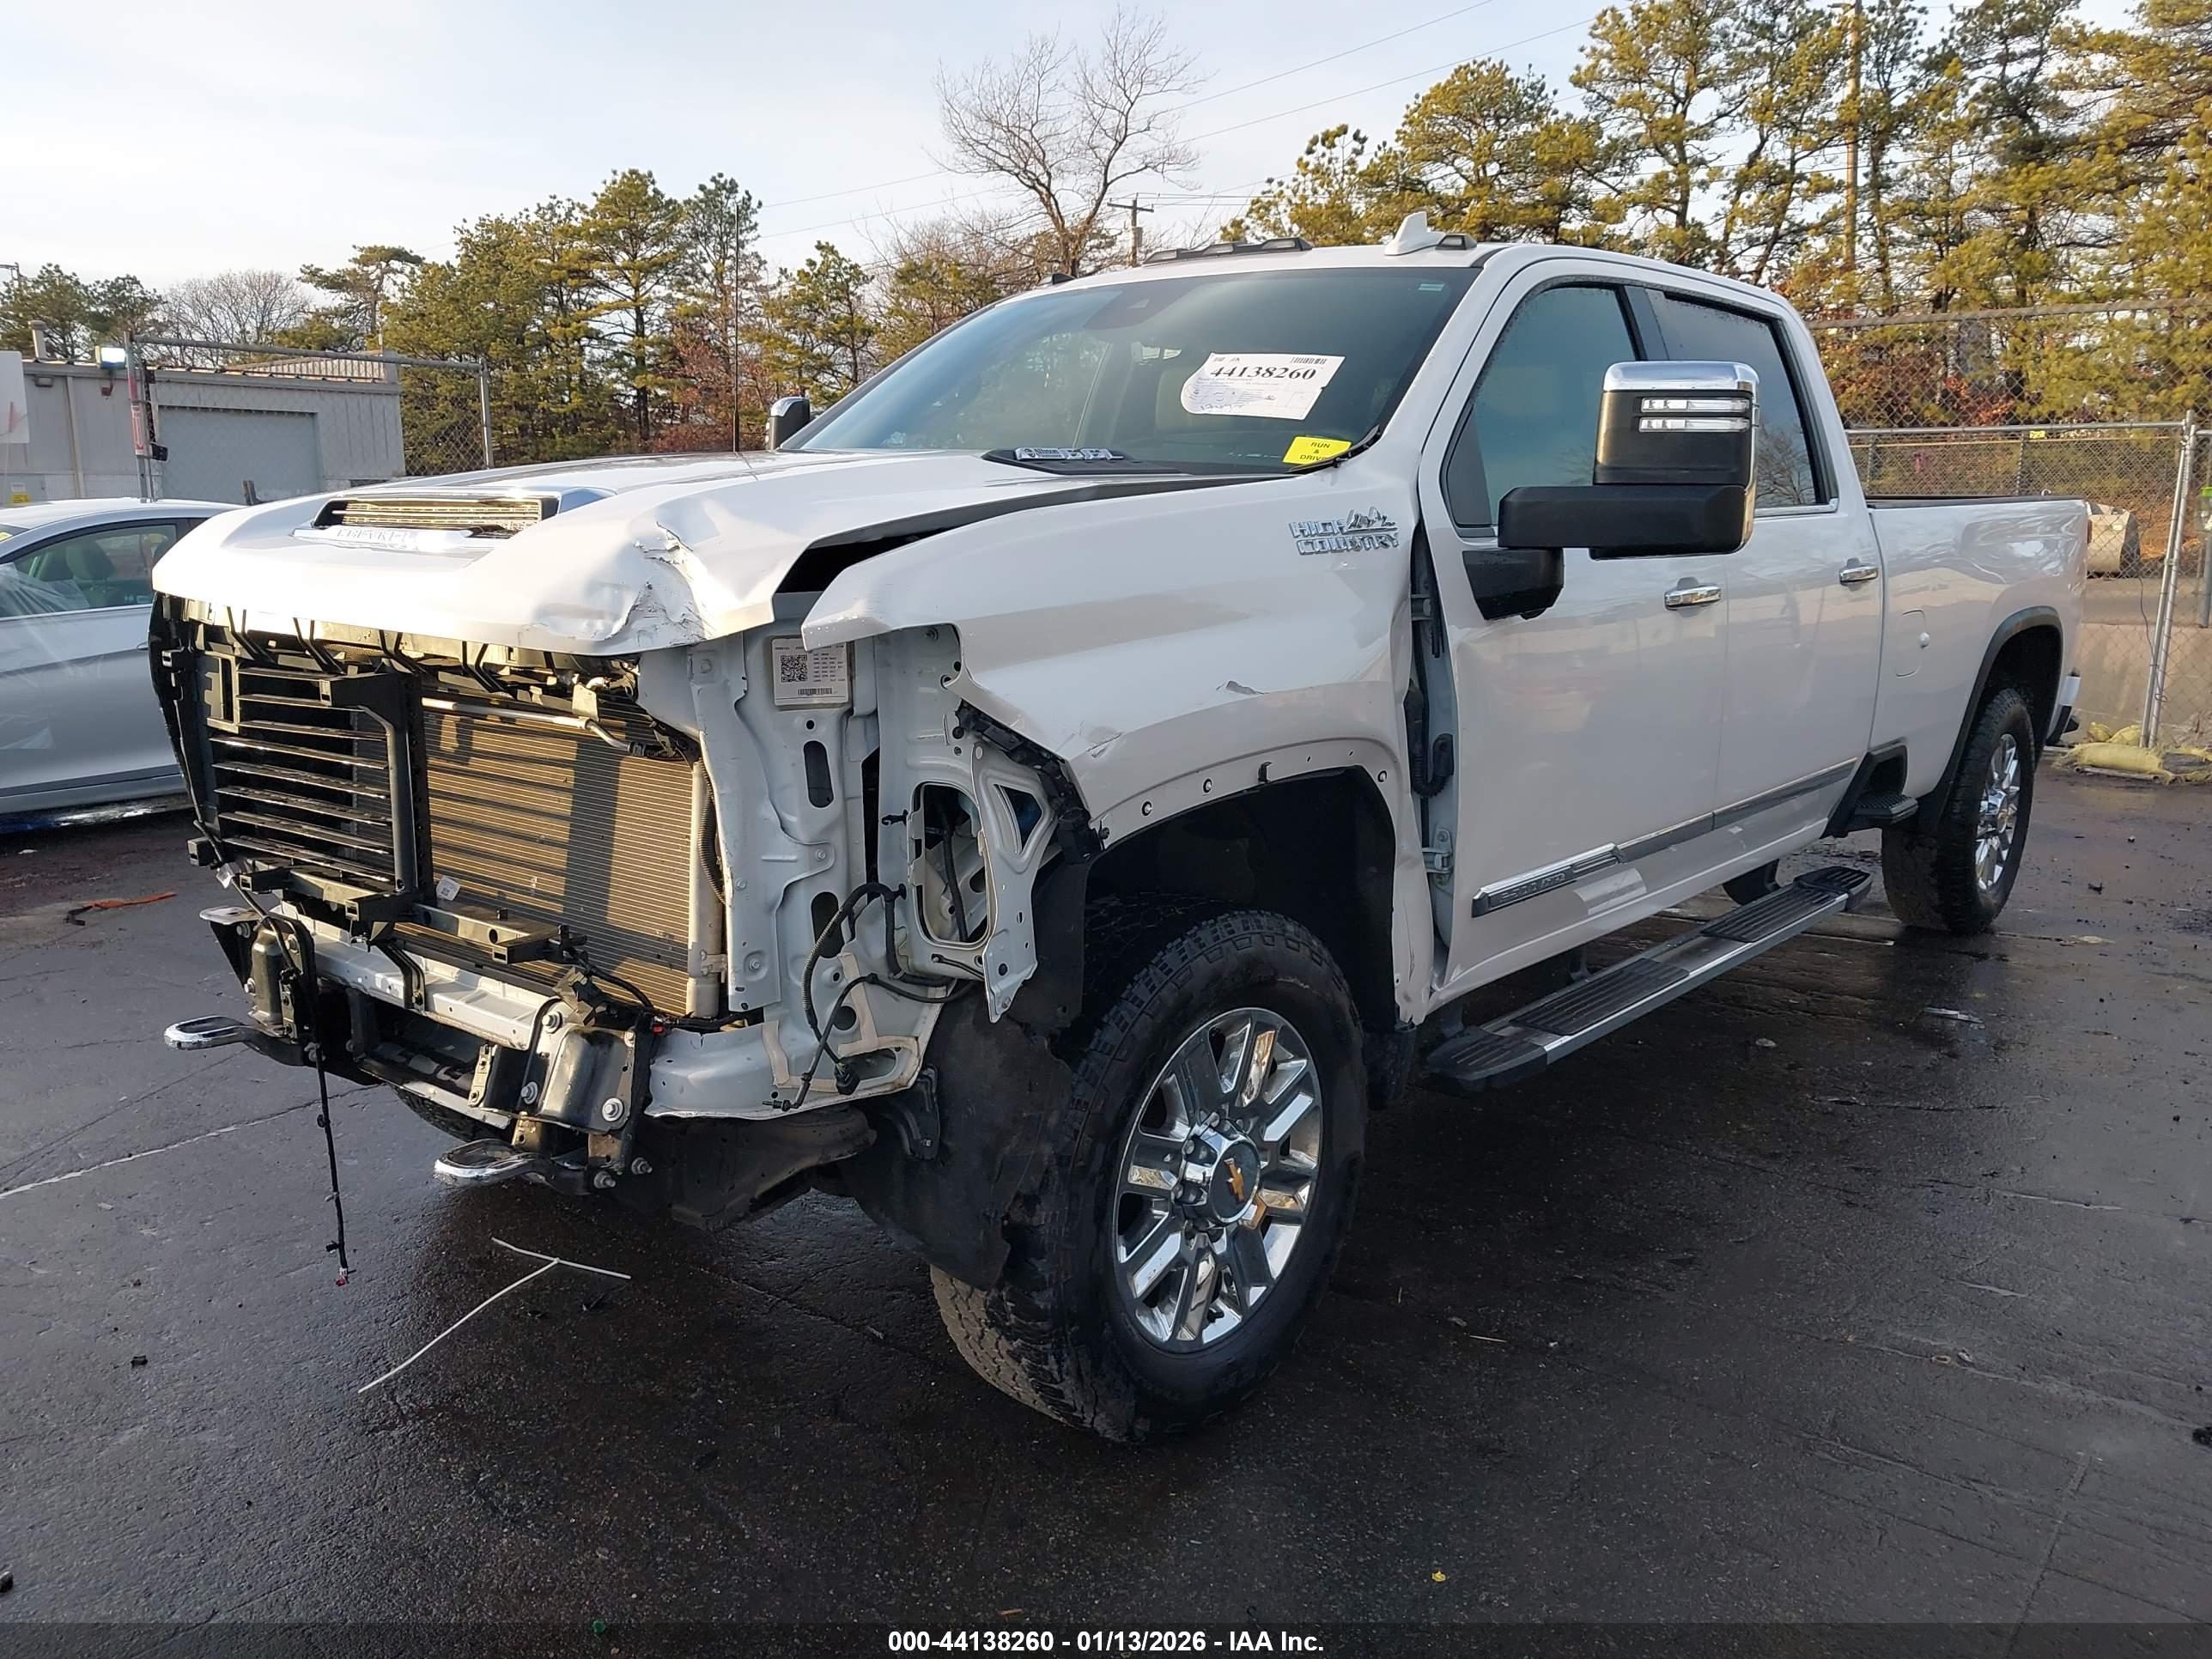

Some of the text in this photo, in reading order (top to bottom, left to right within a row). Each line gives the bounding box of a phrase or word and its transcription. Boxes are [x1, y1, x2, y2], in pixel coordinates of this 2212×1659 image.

[1210, 366, 1316, 380] 44138260
[1289, 520, 1348, 538] HIGH
[1297, 532, 1400, 556] COUNTRY
